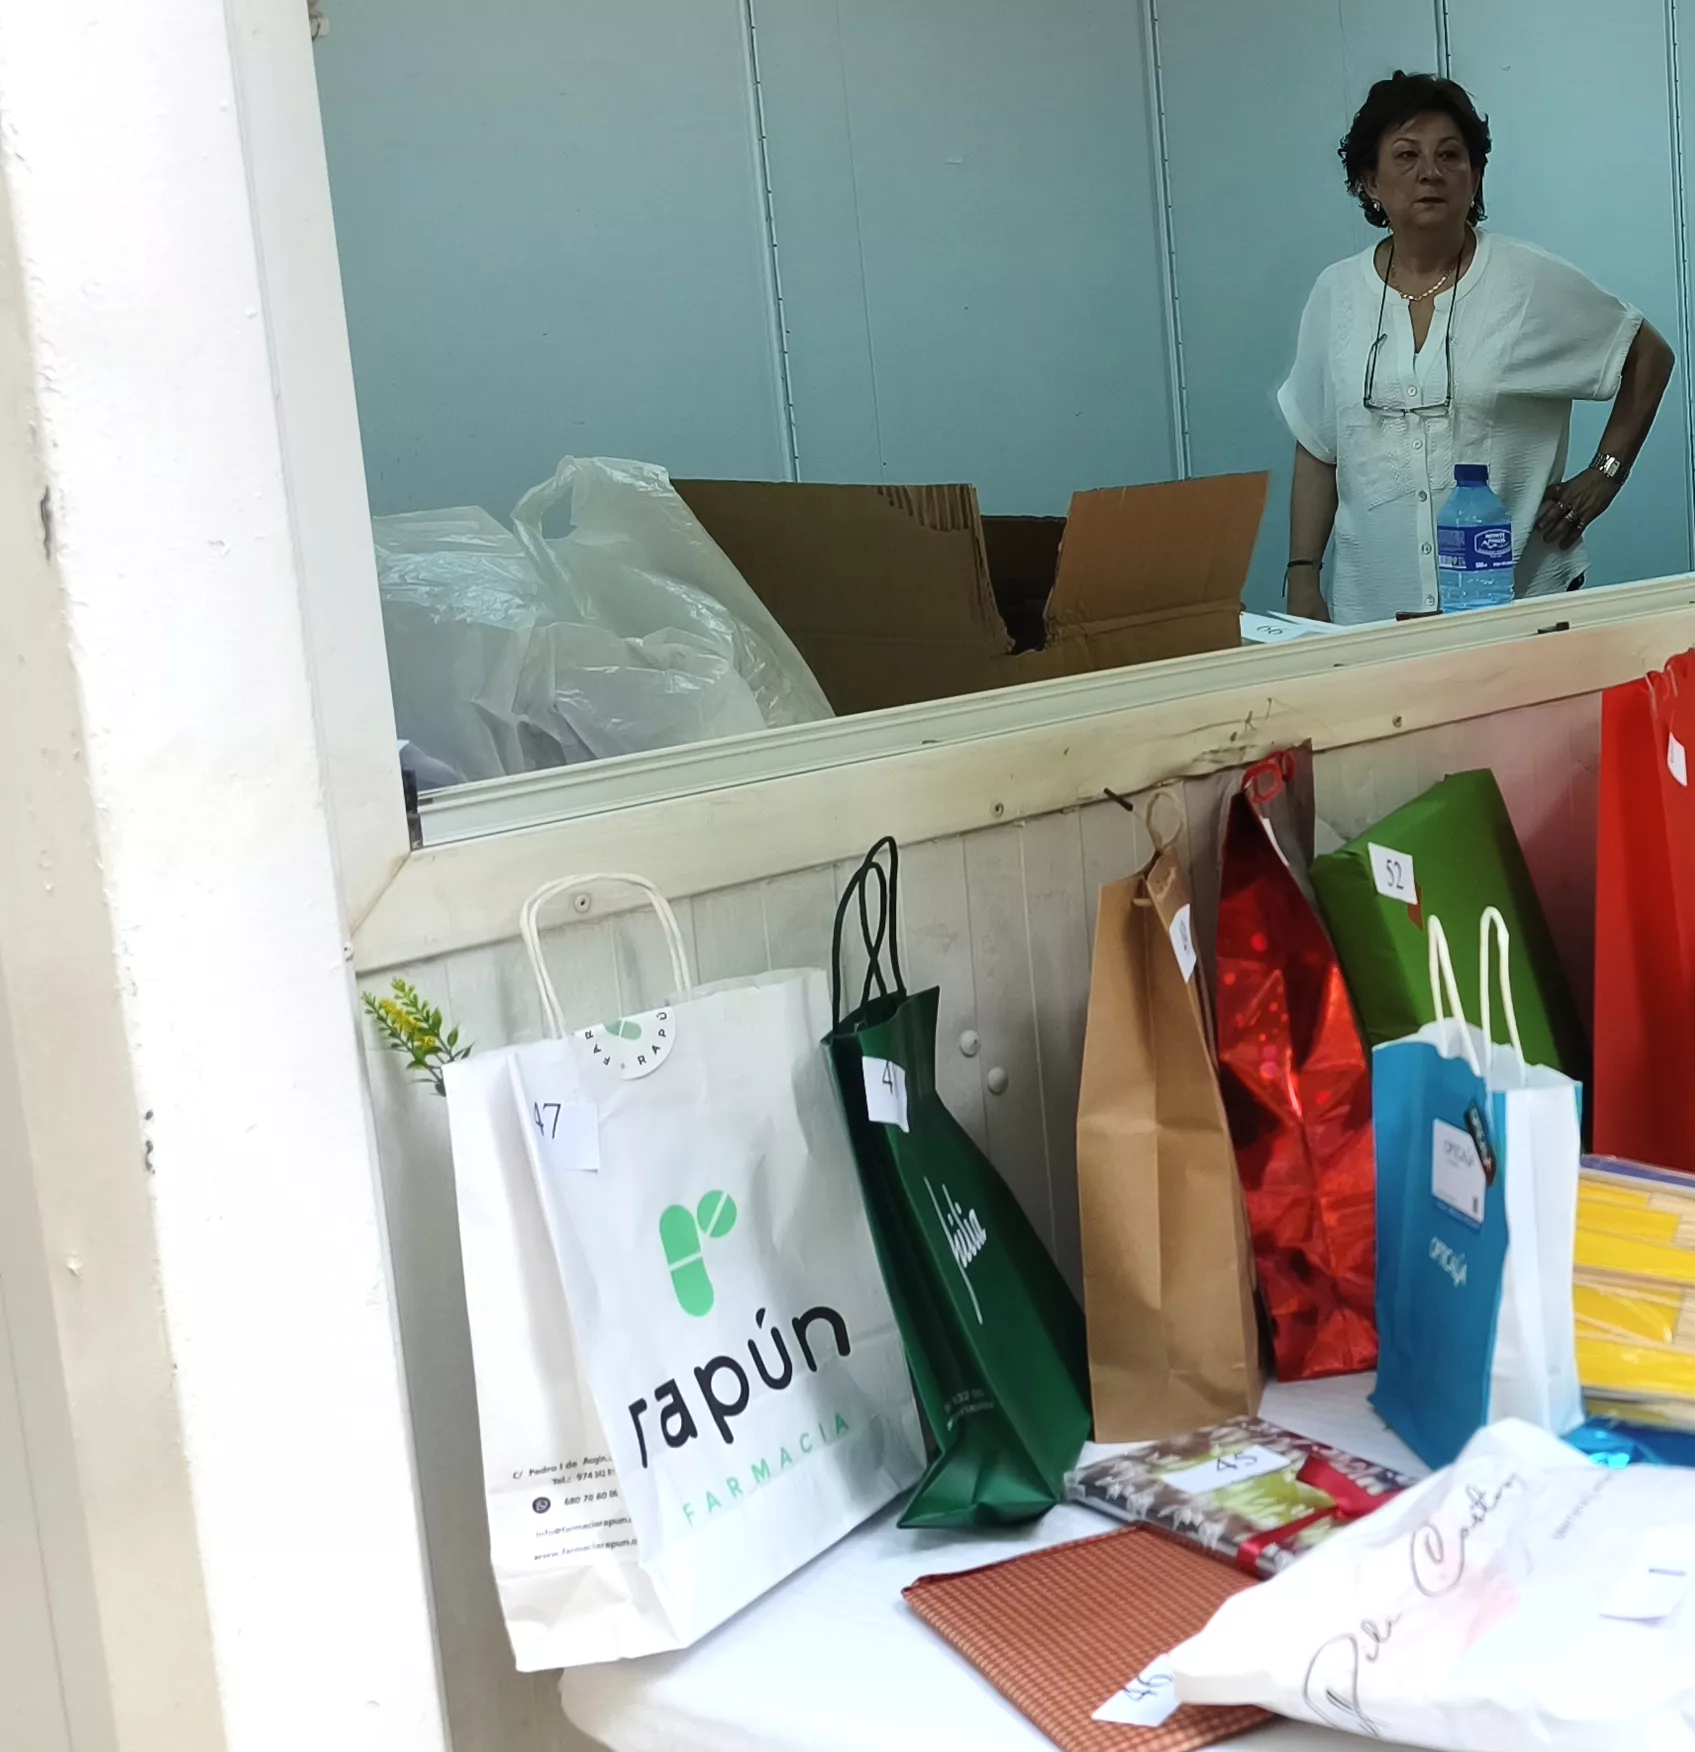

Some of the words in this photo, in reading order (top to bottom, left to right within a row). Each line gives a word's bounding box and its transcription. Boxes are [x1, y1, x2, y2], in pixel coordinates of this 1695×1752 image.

[1386, 859, 1405, 890] 52
[533, 1102, 562, 1139] 47
[628, 1307, 851, 1469] rapún
[682, 1412, 850, 1527] FARMACIA
[1216, 1452, 1259, 1473] 45
[1123, 1672, 1174, 1703] 46
